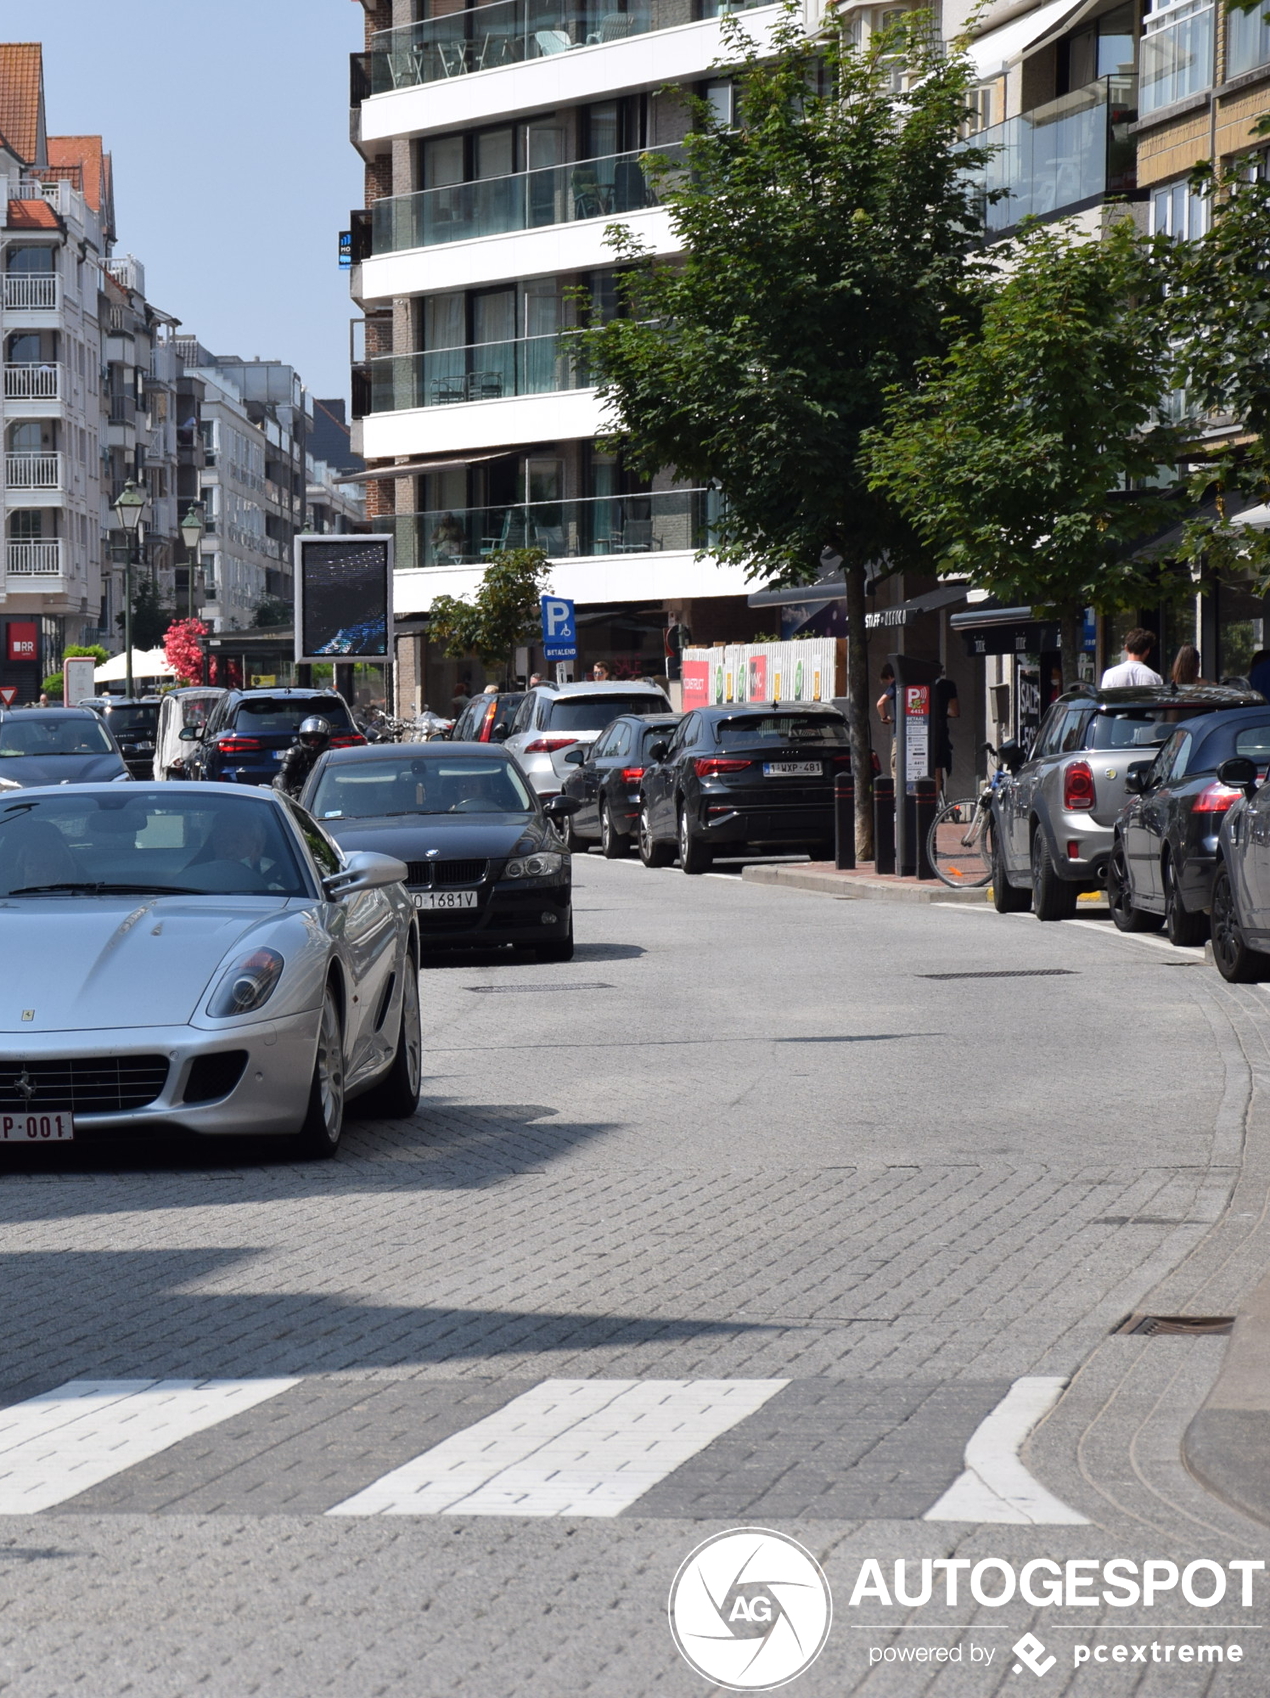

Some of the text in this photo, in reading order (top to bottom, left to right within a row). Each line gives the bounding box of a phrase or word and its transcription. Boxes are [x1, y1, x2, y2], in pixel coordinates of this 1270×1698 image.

[546, 601, 570, 636] P
[1020, 682, 1039, 715] SALE
[411, 892, 474, 908] O 1681V
